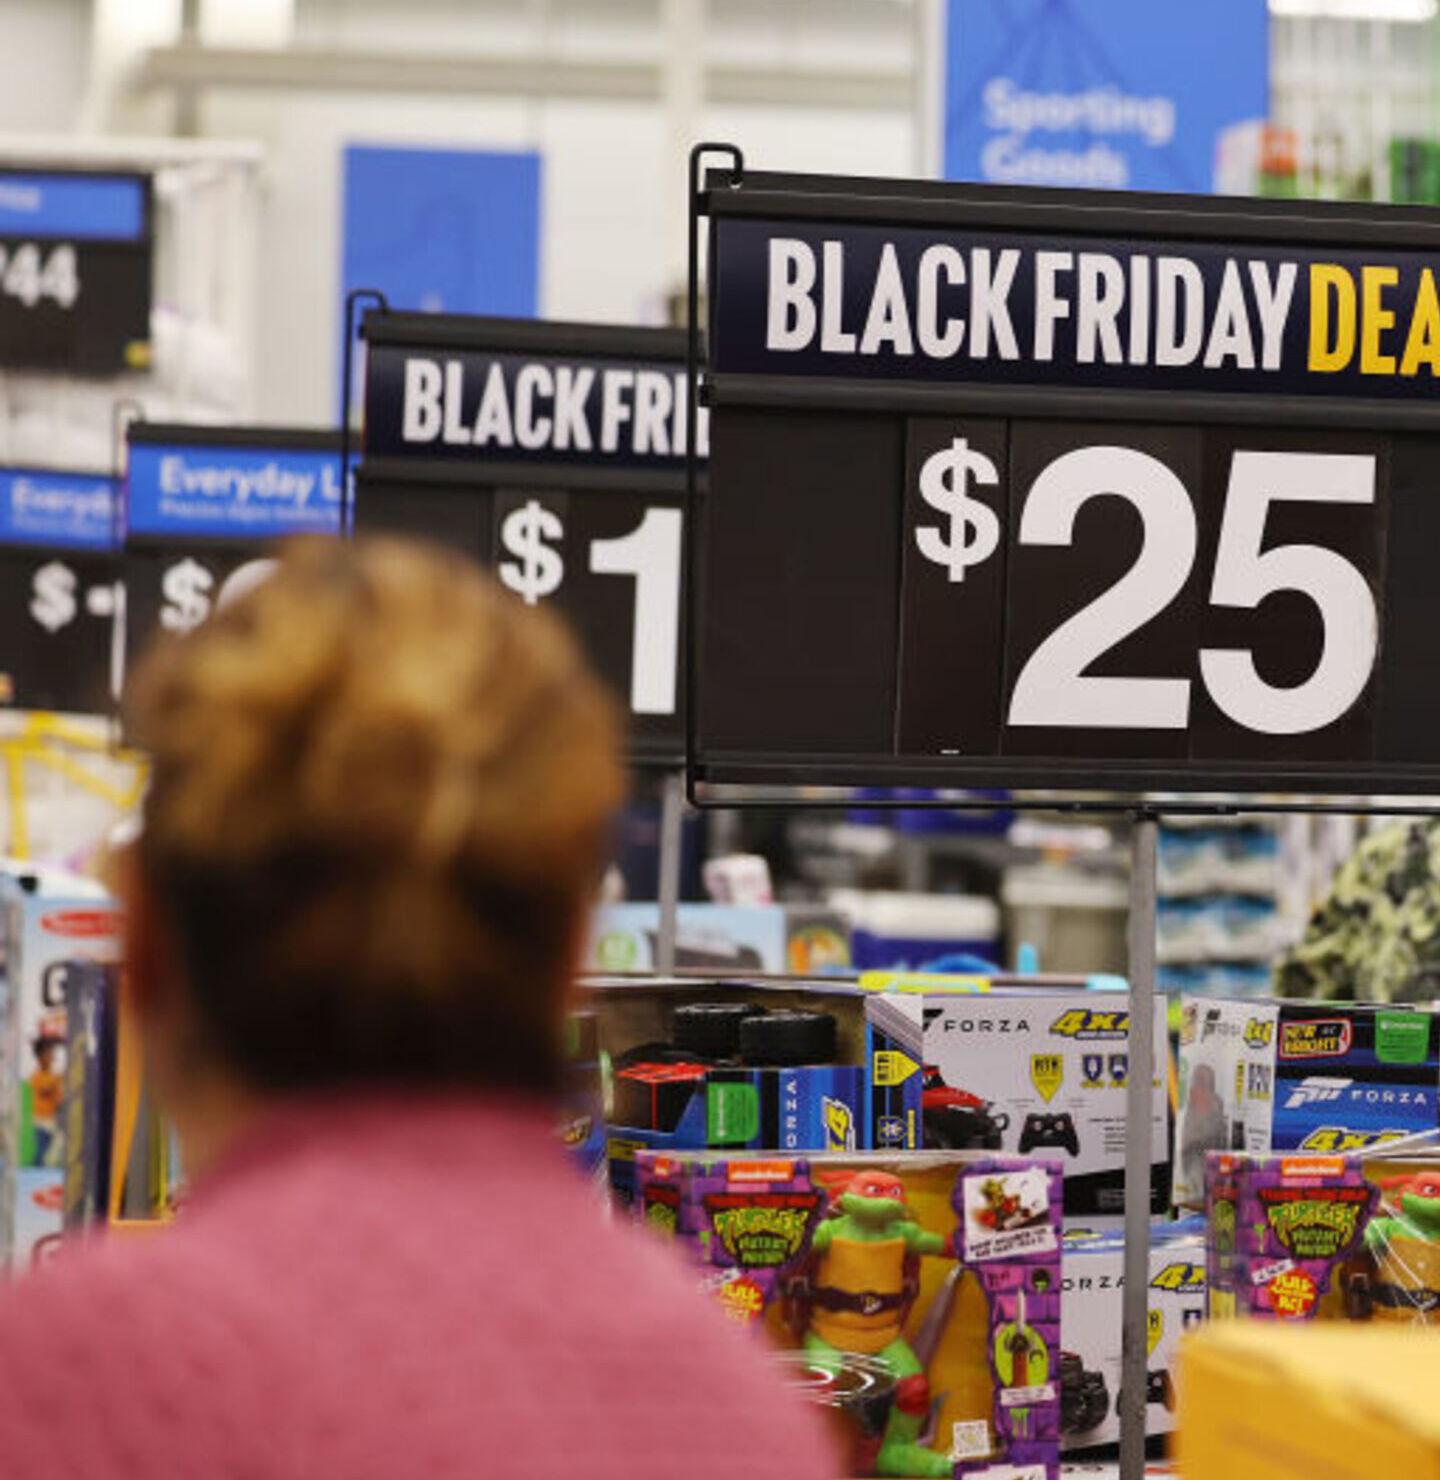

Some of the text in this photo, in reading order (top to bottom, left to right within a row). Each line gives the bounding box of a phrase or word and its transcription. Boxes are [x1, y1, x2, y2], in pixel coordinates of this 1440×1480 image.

[0, 242, 79, 307] 44
[766, 237, 1021, 361] BLACK
[1034, 250, 1298, 371] FRIDAY
[402, 358, 710, 457] BLACK FRI
[159, 455, 314, 508] Everyday
[943, 1018, 1031, 1033] FORZA
[785, 1079, 798, 1148] ORZA
[1351, 1089, 1427, 1106] FORZA
[1060, 1276, 1127, 1292] ORZA
